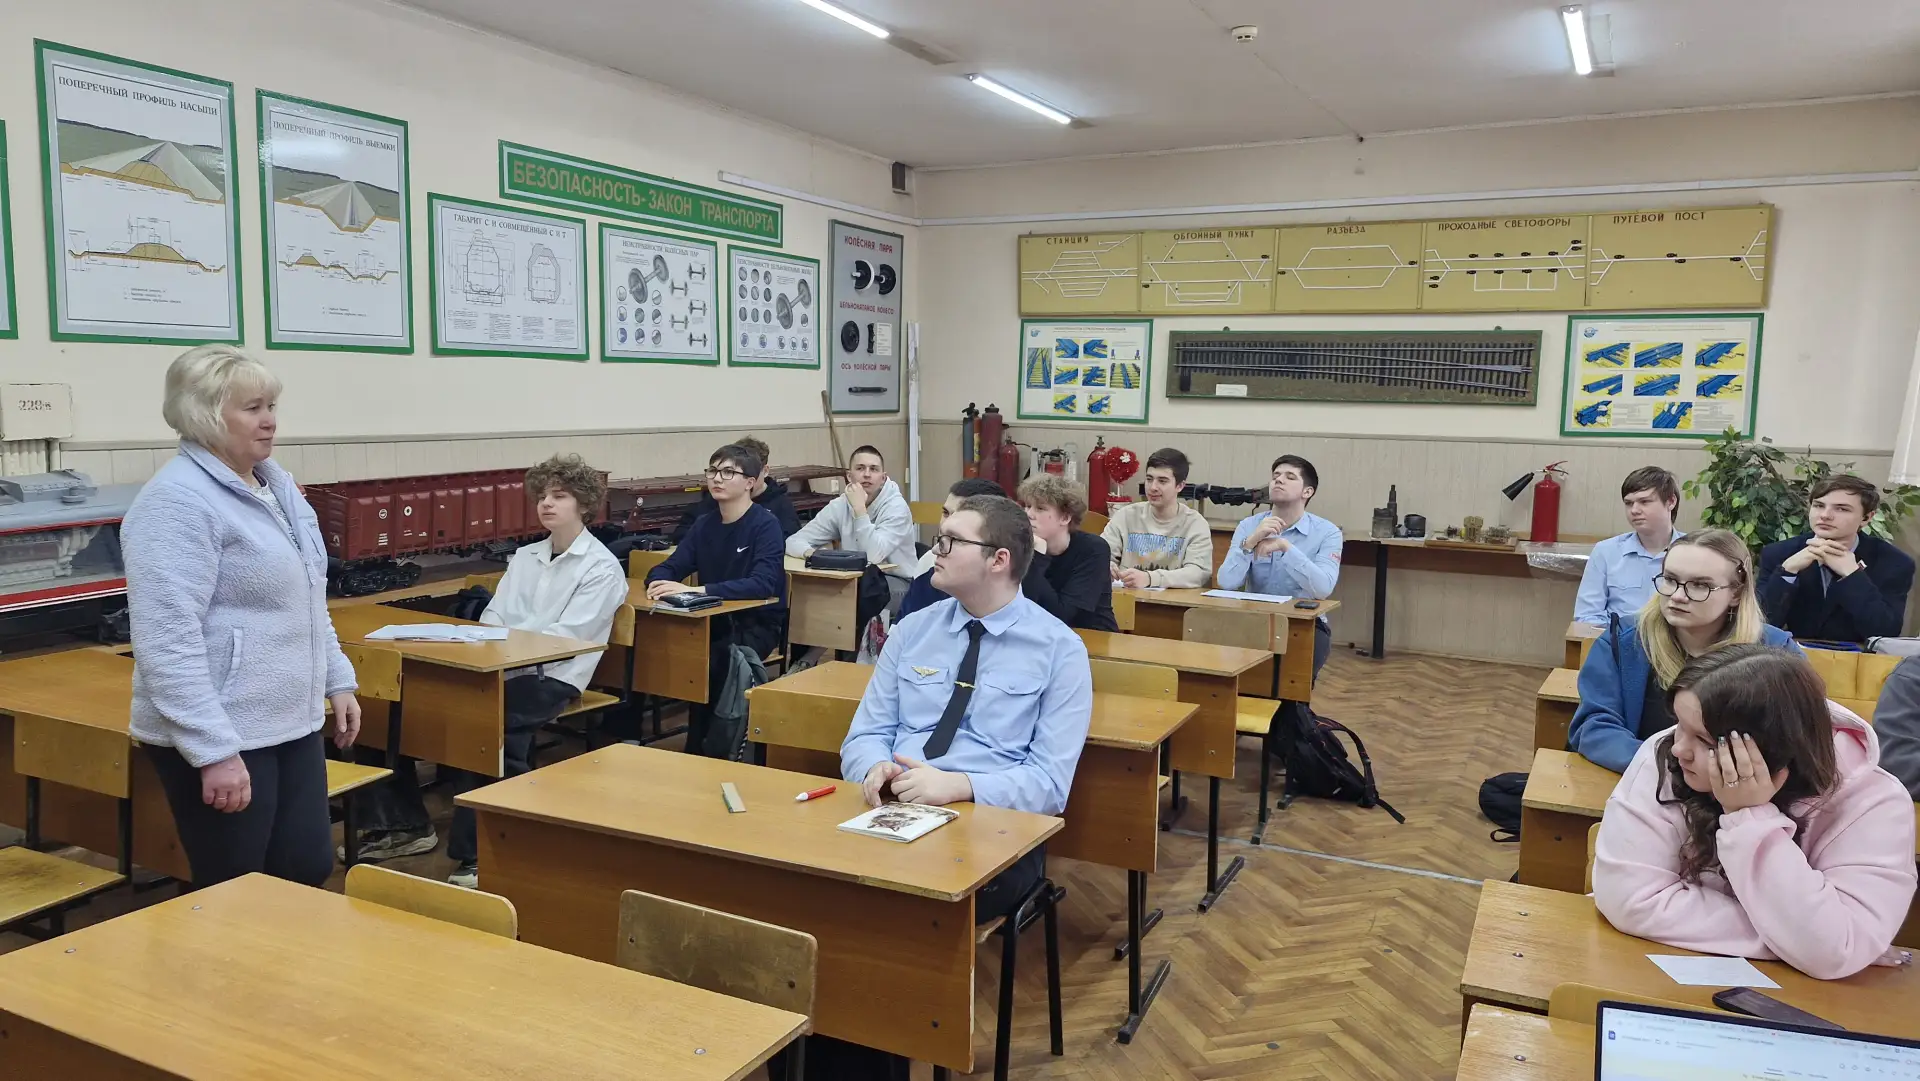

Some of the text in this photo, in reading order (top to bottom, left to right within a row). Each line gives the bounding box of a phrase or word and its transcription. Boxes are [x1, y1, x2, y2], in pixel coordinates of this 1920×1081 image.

[58, 76, 218, 116] ПОПЕРЕЧНЫЙ ПРОФИЛЬ НАСЫПИ
[272, 120, 396, 151] ПОПЕРЕЧНЫЙ ПРОФИЛЬ ВЫЕМКИ
[453, 213, 482, 225] ГАБАРИТ
[484, 218, 489, 226] С
[491, 219, 497, 227] И
[700, 201, 775, 233] ТРАНСПОРТА
[1438, 217, 1571, 231] ПРОХОДНЫЕ СВЕТОФОРЫ
[1613, 211, 1705, 224] ПУТЕВОЙ ПОСТ
[1173, 230, 1254, 241] ОБГОННЫЙ ПУНКТ
[1326, 225, 1366, 235] РАЗЪЕЗД
[844, 235, 893, 254] КОЛЁСНАЯ ПАРА
[1046, 235, 1089, 245] СТАНЦИЯ
